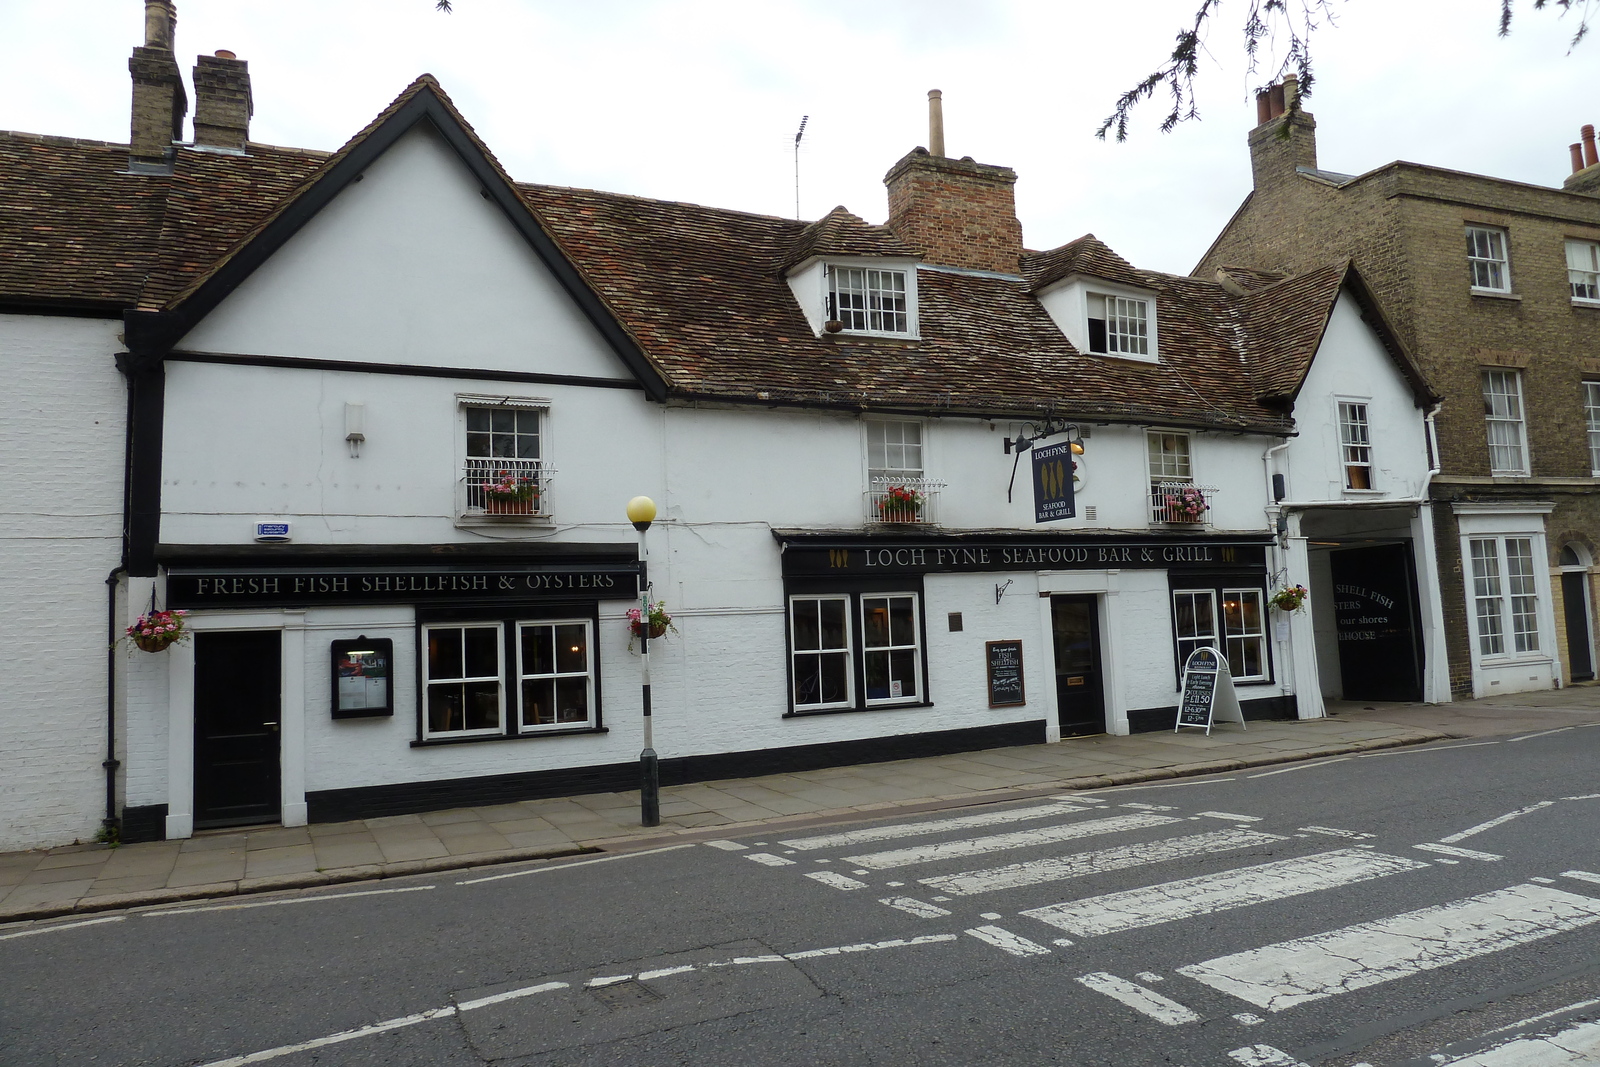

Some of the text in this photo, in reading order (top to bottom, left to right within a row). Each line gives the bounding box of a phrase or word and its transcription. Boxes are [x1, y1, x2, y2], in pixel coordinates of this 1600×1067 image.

[1035, 445, 1067, 460] LOCH FYNE
[1043, 501, 1066, 511] SEAFOOD
[1038, 511, 1049, 519] BAR
[1055, 508, 1071, 516] GRILL
[865, 546, 1213, 566] LOCH FYNE SEAFOOD BAR & GRILL
[196, 574, 615, 595] FRESH FISH SHELLFISH & OYSTERS
[1336, 584, 1394, 610] SHELL FISH
[1358, 615, 1388, 624] shores
[1184, 689, 1191, 698] 2
